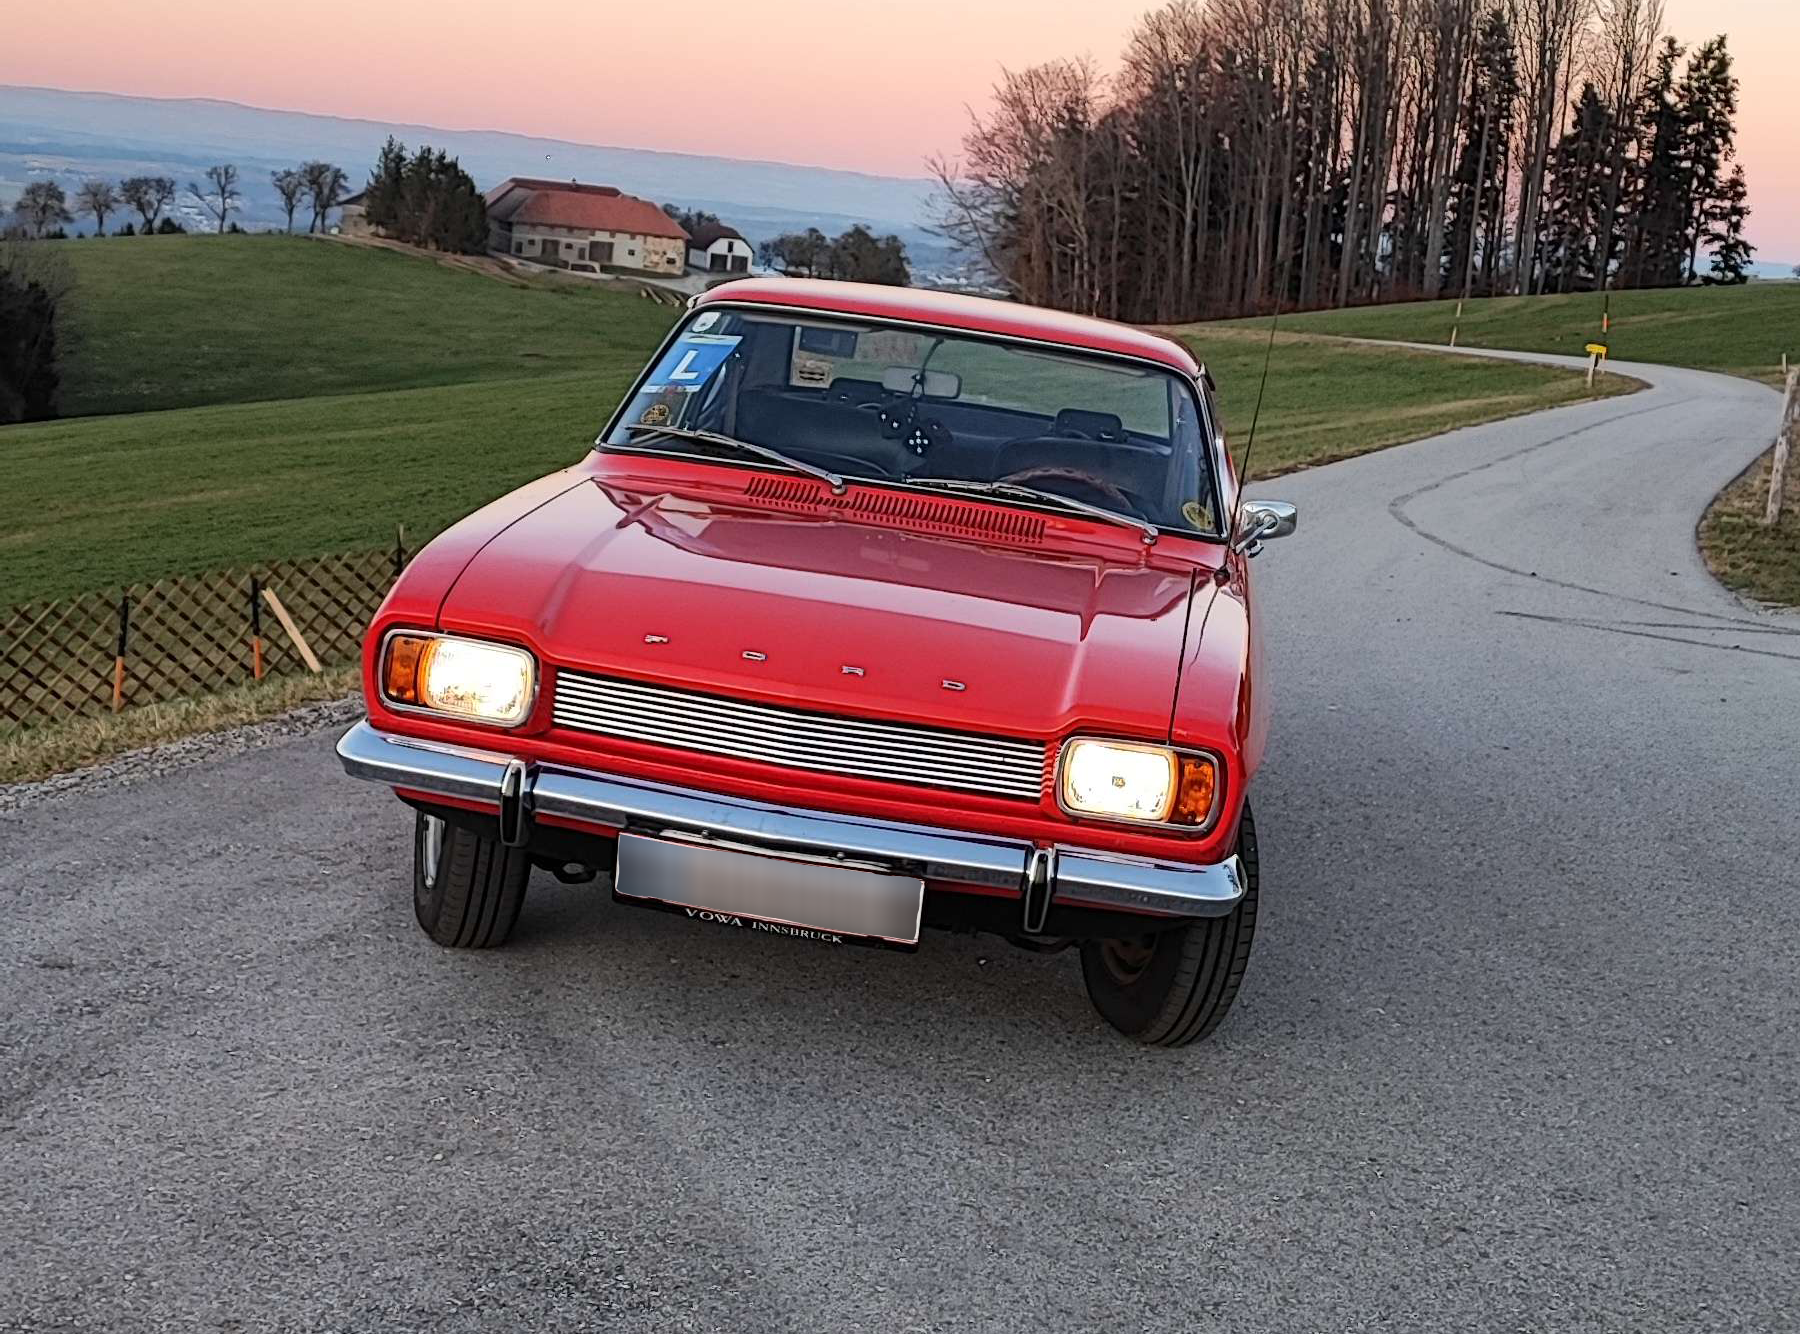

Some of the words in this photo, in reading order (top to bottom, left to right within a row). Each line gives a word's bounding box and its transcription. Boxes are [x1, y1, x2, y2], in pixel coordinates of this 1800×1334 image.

[668, 349, 699, 380] L
[685, 908, 743, 927] VOWA
[752, 921, 843, 944] INNSBRUCK
